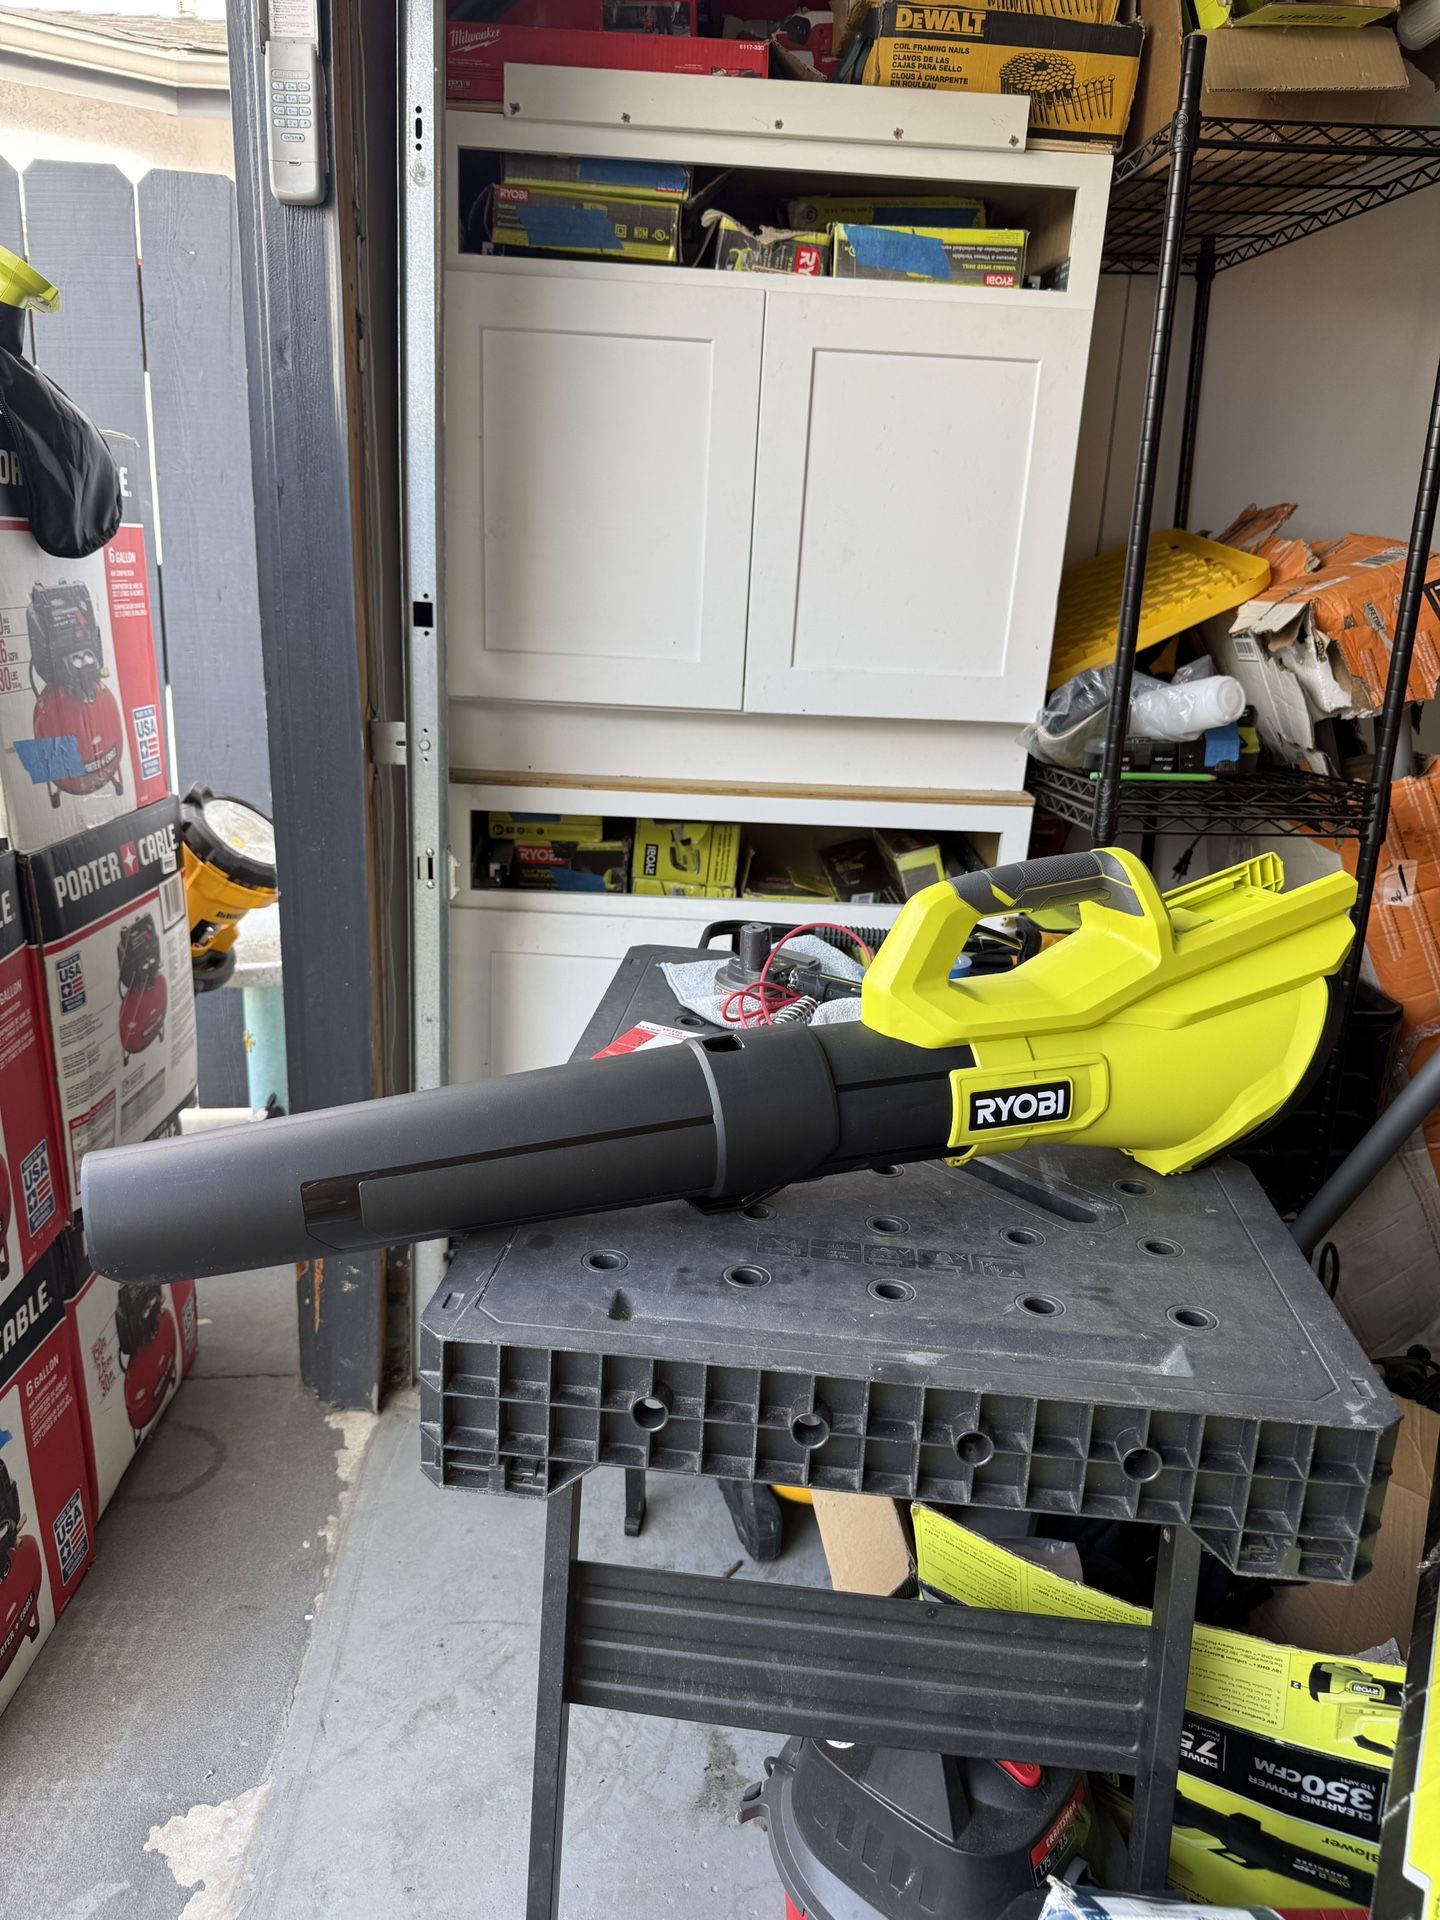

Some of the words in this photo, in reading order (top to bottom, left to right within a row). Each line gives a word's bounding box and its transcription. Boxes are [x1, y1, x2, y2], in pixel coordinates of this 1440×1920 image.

[448, 27, 501, 47] Milwaukee
[892, 54, 922, 62] CLAVOS
[913, 44, 946, 52] FRAMING
[948, 46, 970, 54] NAILS
[891, 72, 916, 80] CLOUS
[924, 75, 968, 84] CHARPENTE
[902, 81, 936, 90] ROULEAU
[500, 188, 528, 200] RYOBI
[985, 274, 1013, 286] RYOBI
[136, 718, 156, 738] USA
[53, 850, 122, 908] PORTER
[138, 824, 178, 865] CABLE
[644, 846, 657, 874] RYOBI
[59, 964, 81, 982] USA
[975, 1088, 1064, 1124] RYOBI
[24, 1156, 48, 1191] USA
[0, 1280, 47, 1362] ABLE
[25, 1378, 33, 1398] 6
[33, 1352, 59, 1389] GALLON
[56, 1504, 82, 1546] USA
[1352, 1684, 1380, 1696] RYOBI
[1240, 1710, 1265, 1721] Cordless
[1178, 1748, 1219, 1769] POWE
[1246, 1773, 1298, 1799] POWER
[1339, 1775, 1359, 1787] MPH
[1360, 1781, 1376, 1792] 110
[1299, 1792, 1372, 1822] CLEARING
[1044, 1799, 1077, 1849] CRAFTSMAN
[1320, 1835, 1381, 1865] Blower
